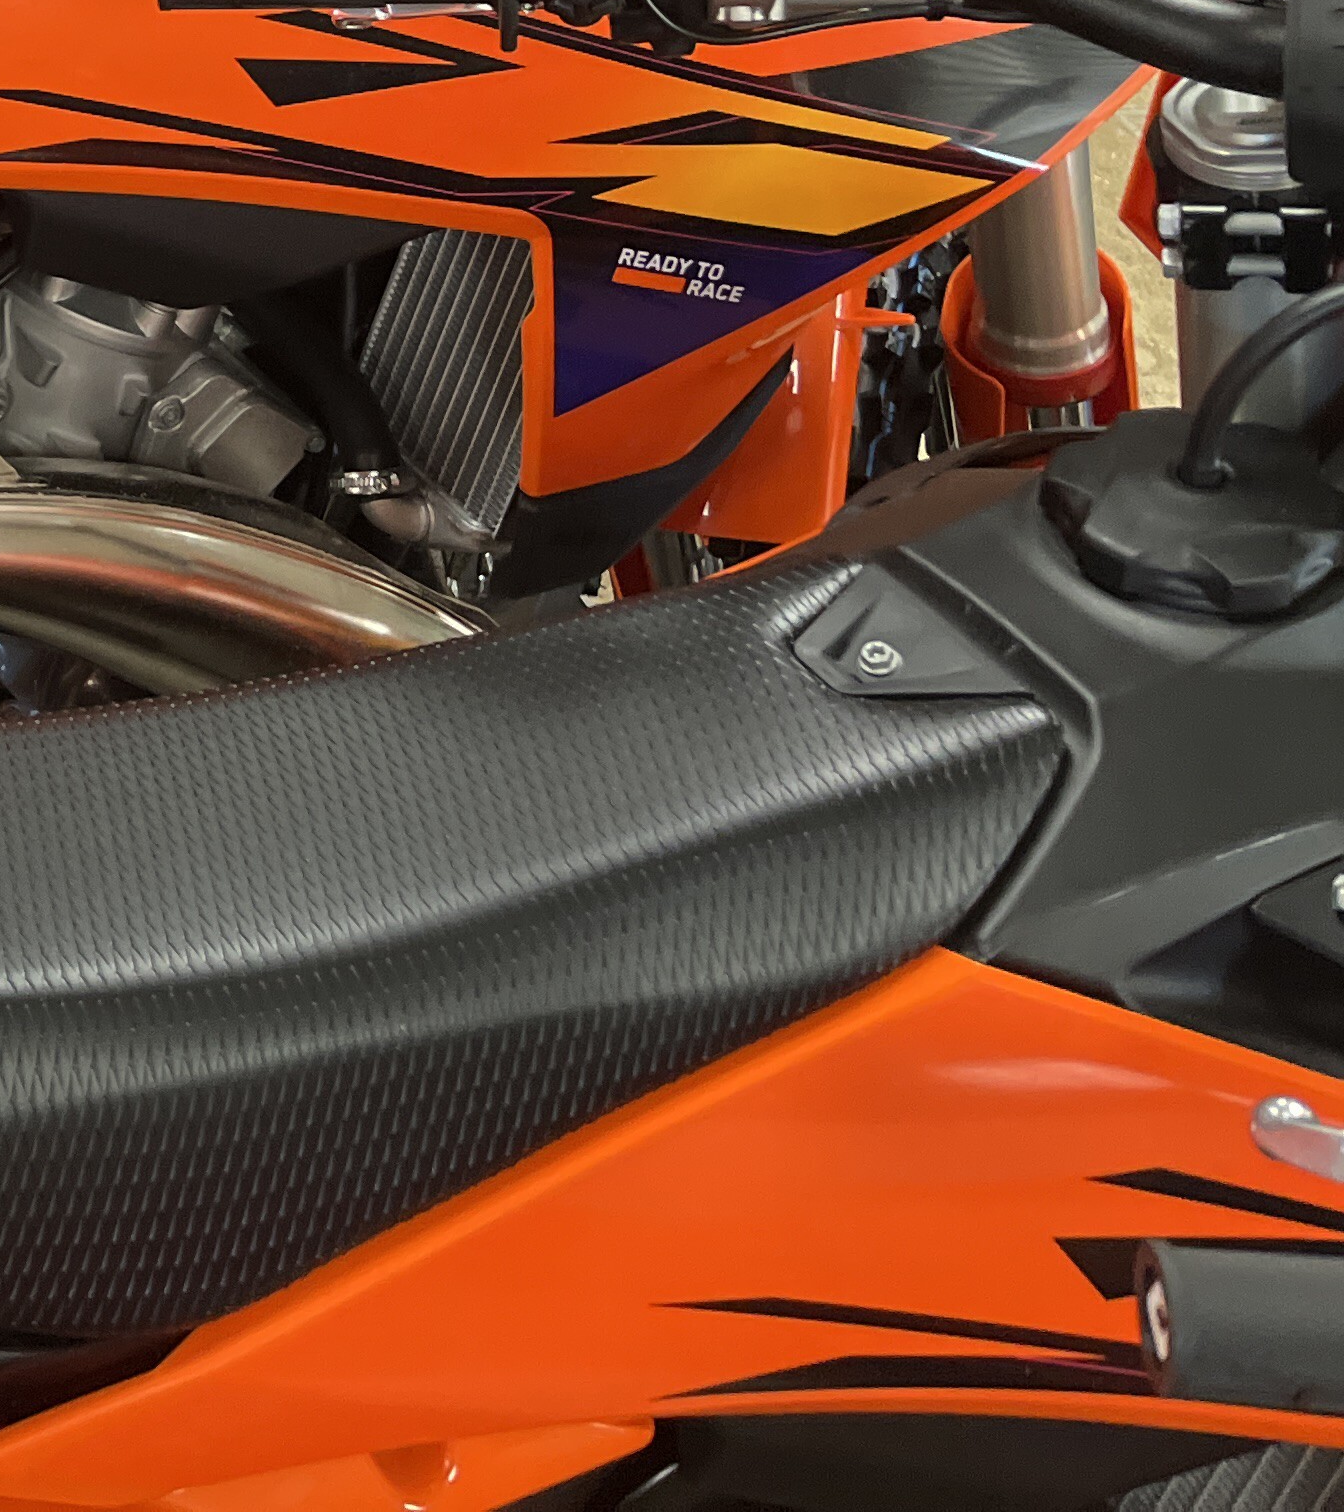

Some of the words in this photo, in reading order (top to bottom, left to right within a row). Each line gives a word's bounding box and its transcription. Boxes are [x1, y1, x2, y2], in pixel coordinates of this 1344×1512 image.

[617, 247, 694, 276] READY
[697, 260, 725, 281] TO
[686, 279, 746, 303] RACE
